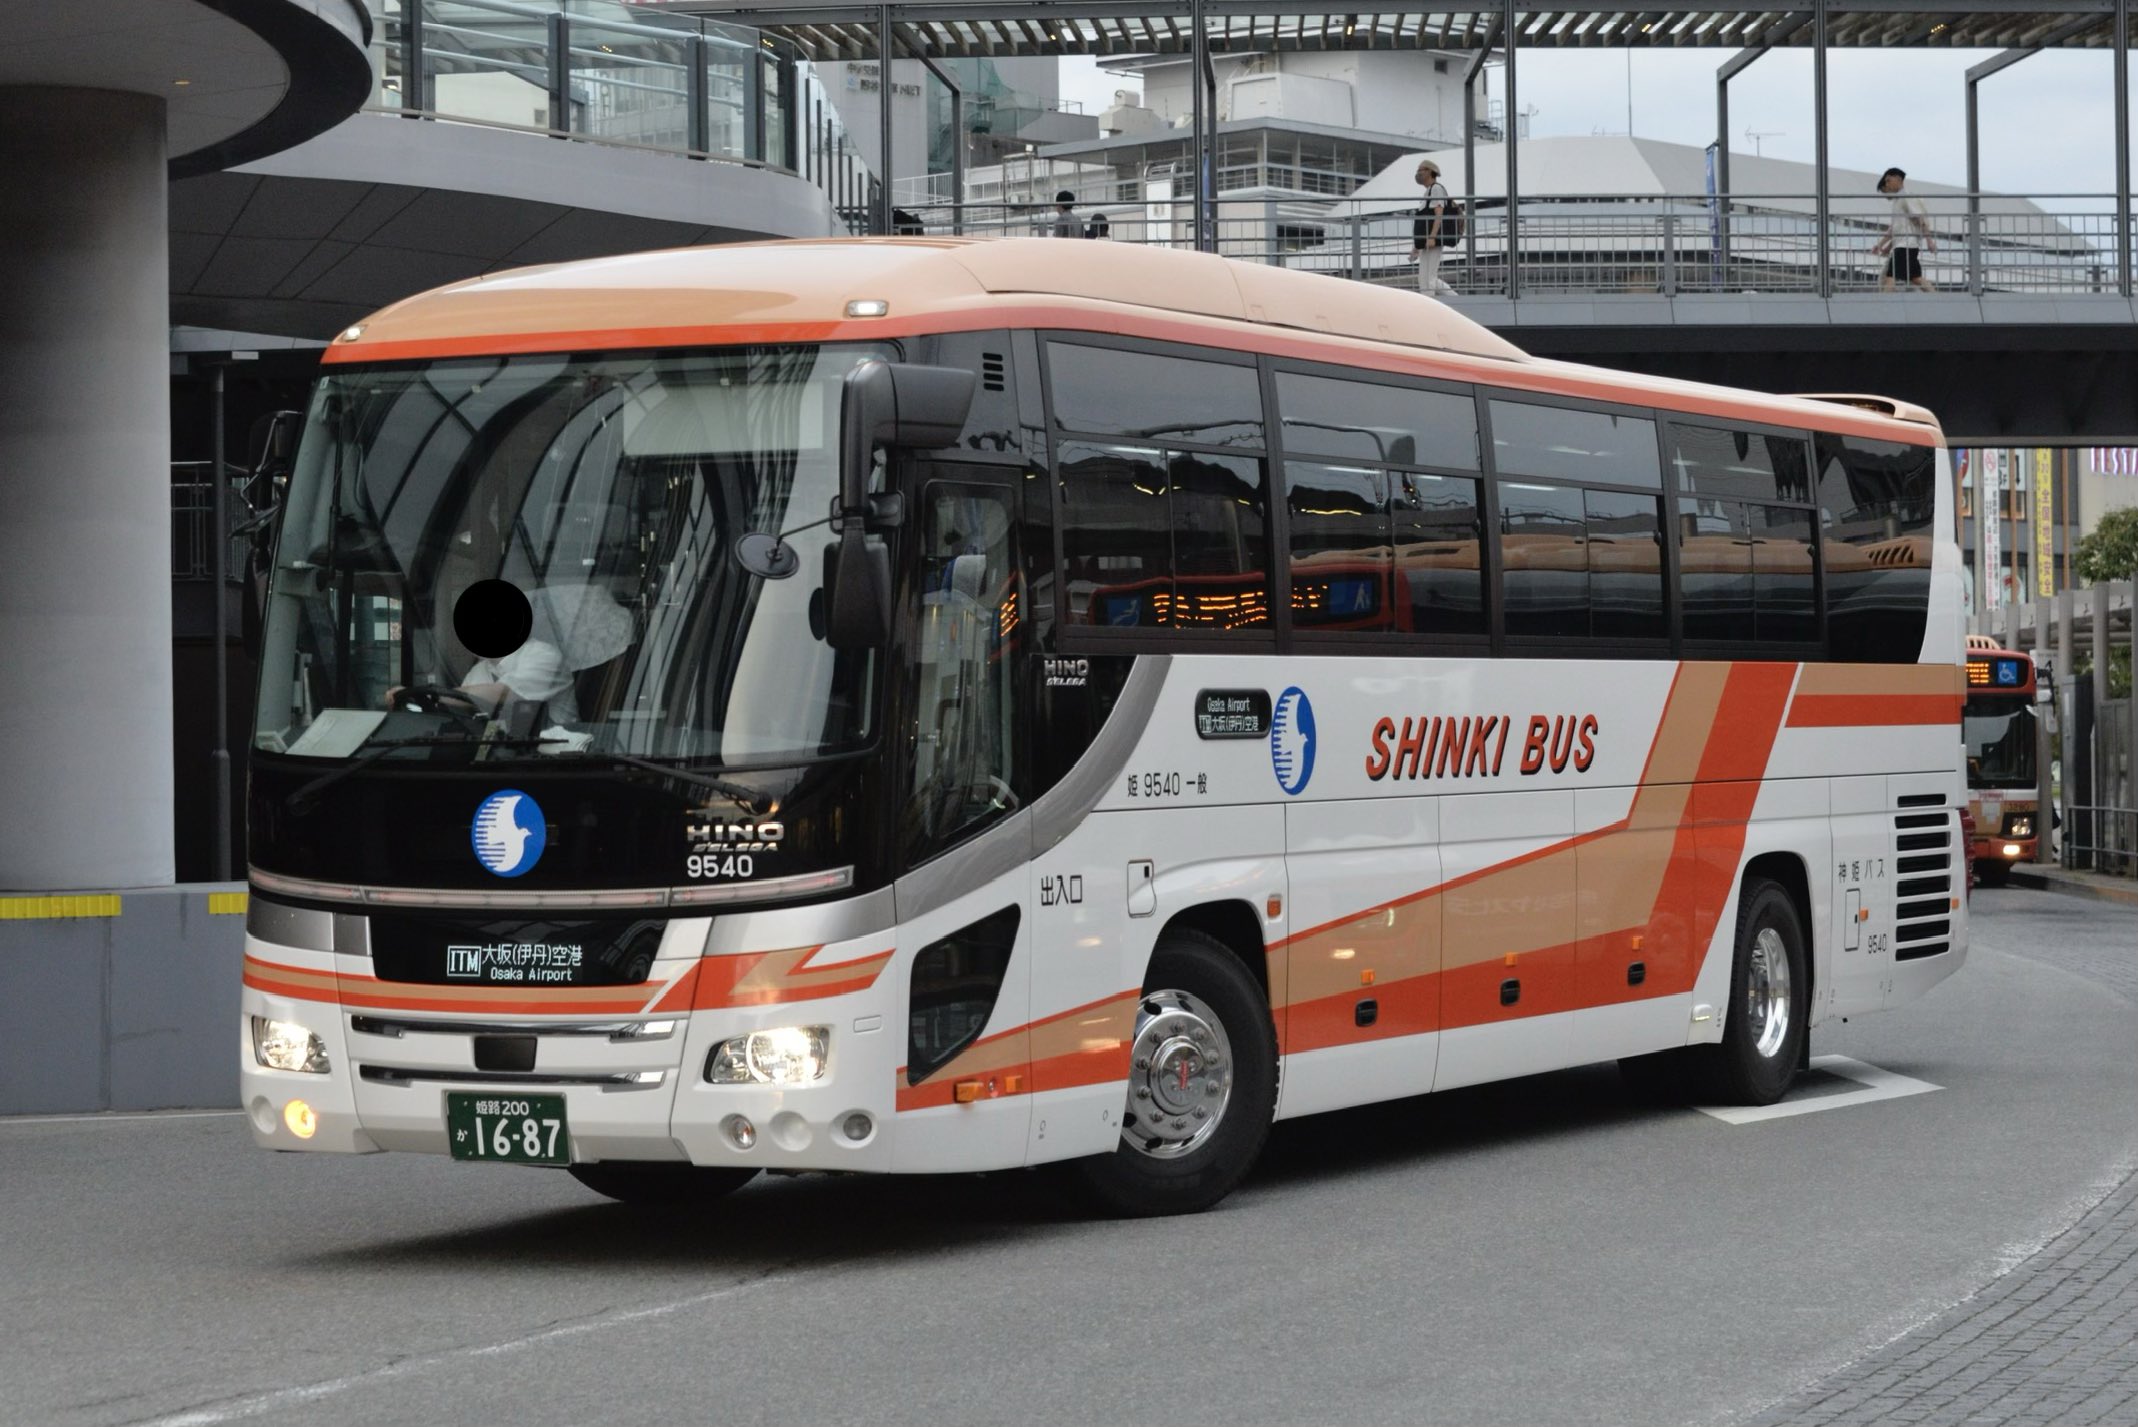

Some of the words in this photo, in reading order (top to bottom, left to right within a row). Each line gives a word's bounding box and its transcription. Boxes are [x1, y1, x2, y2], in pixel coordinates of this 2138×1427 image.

[1044, 659, 1089, 676] HINO
[1207, 697, 1225, 712] Osaka
[1227, 697, 1250, 712] Airport
[1366, 716, 1510, 781] SHINKI
[1520, 714, 1598, 775] BUS
[1144, 772, 1180, 797] 9540
[686, 821, 784, 841] HINO
[687, 855, 753, 877] 9540
[1041, 875, 1082, 906] 出入口
[1868, 934, 1887, 954] 9540
[449, 950, 479, 973] ITM
[482, 943, 582, 967] 大阪(伊丹)空港
[490, 967, 523, 980] Osaka
[528, 967, 572, 982] Airport
[475, 1117, 560, 1158] 16-87
